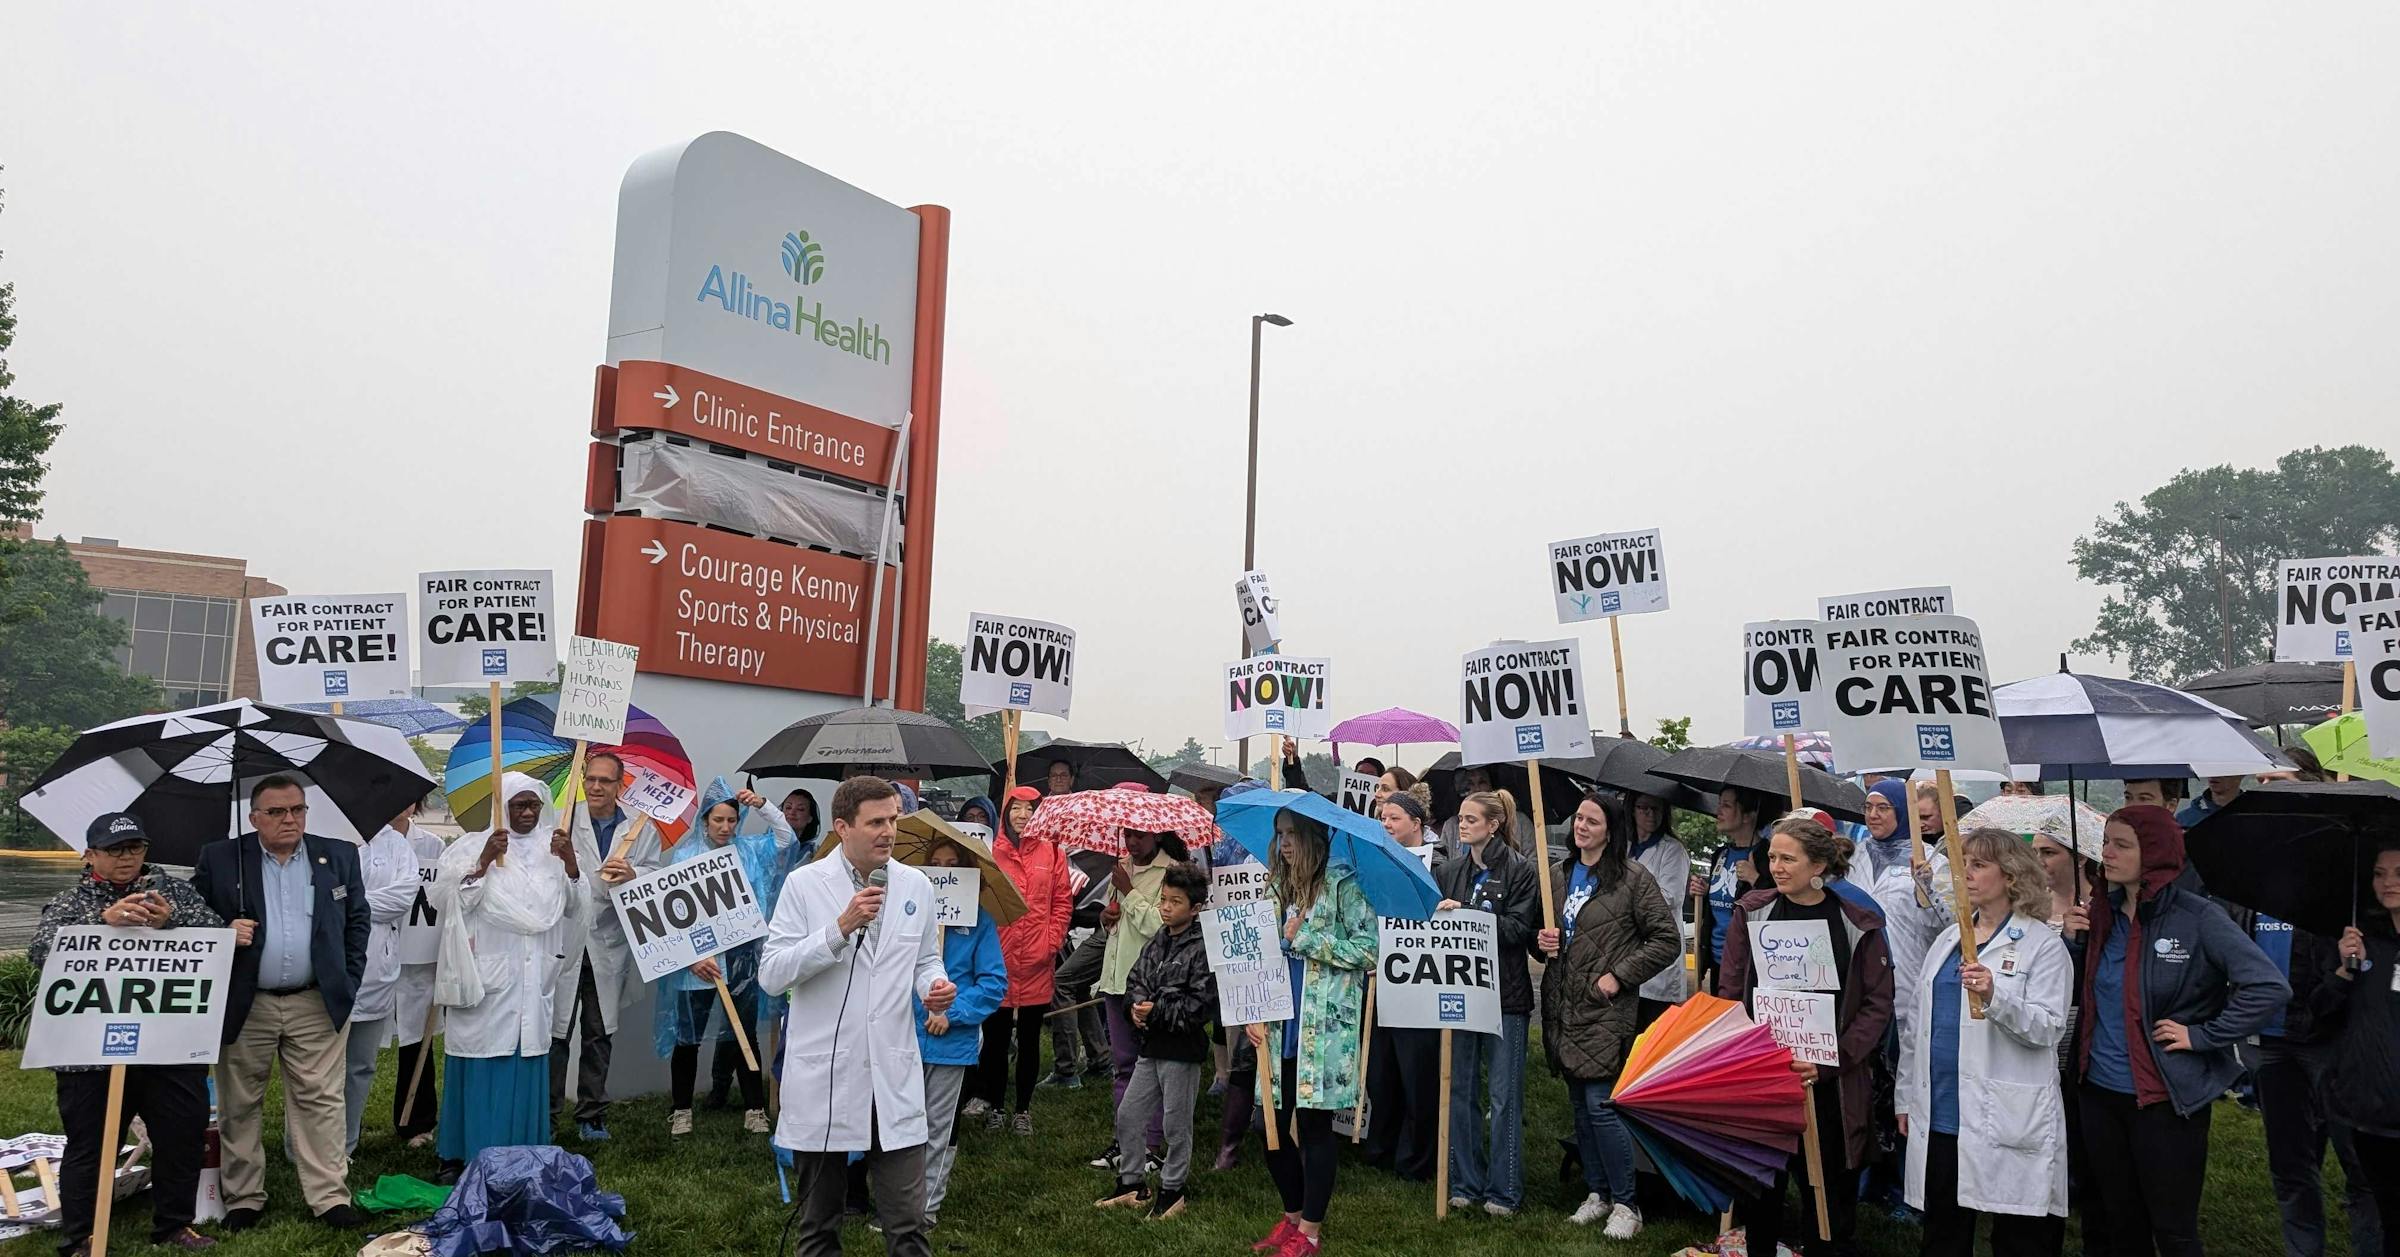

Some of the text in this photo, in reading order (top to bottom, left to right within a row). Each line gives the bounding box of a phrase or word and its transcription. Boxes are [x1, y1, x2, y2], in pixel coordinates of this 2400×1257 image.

[693, 390, 865, 467] Clinic Entrance
[1555, 535, 1653, 559] FAIR CONTRACT
[681, 543, 859, 612] Courage Kenny
[1556, 549, 1659, 594] NOW!
[2287, 567, 2321, 582] FAIR
[427, 579, 541, 593] FAIR CONTRACT
[261, 603, 394, 617] FAIR CONTRACT
[439, 596, 536, 610] FOR PATIENT
[1827, 596, 1944, 620] FAIR CONTRACT
[277, 618, 386, 632] FOR PATIENT
[678, 589, 860, 644] Sports & Physical
[428, 612, 546, 645] CARE!
[975, 620, 1072, 648] FAIR CONTRACT
[1827, 628, 1889, 649] FAIR
[266, 634, 397, 665] CARE!
[572, 638, 638, 660] HEALTH CARE
[676, 631, 766, 677] Therapy
[970, 635, 1071, 686] NOW!
[1230, 661, 1324, 679] FAIR CONTRACT
[1465, 648, 1570, 677] FAIR CONTRACT
[1849, 651, 1981, 672] FOR PATIENT
[570, 672, 622, 690] HUMANS
[1230, 673, 1324, 712] NOW!
[1465, 668, 1578, 724] NOW!
[563, 711, 624, 732] HUMANS!!
[818, 746, 893, 757] TaylorMade
[642, 768, 686, 799] WE ALL
[1345, 778, 1371, 792] FAIR
[622, 787, 654, 813] Urgent
[643, 784, 674, 805] NEED
[619, 853, 734, 906] FAIR CONTRACT
[1218, 872, 1249, 887] FAIR
[1228, 891, 1251, 901] FOR
[625, 868, 751, 946] NOW!
[951, 905, 961, 920] it
[1216, 902, 1257, 923] PROTECT
[1232, 918, 1247, 932] MY
[1385, 917, 1490, 936] FAIR CONTRACT
[56, 935, 217, 953] FAIR CONTRACT
[1221, 927, 1261, 945] FUTURE
[1395, 936, 1488, 953] FOR PATIENT
[1759, 924, 1809, 950] Grow
[1223, 941, 1260, 959] CAREER
[1764, 951, 1804, 966] Primary
[64, 957, 203, 973] FOR PATIENT
[1226, 960, 1263, 975] PROTECT
[1384, 953, 1495, 991] CARE!
[1768, 963, 1808, 982] Care!
[44, 978, 213, 1016] CARE!
[1226, 982, 1271, 1006] HEALTH
[1236, 1006, 1267, 1023] CARE
[1756, 995, 1819, 1015] PROTECT
[1759, 1013, 1804, 1029] FAMILY
[1820, 1033, 1834, 1046] TO
